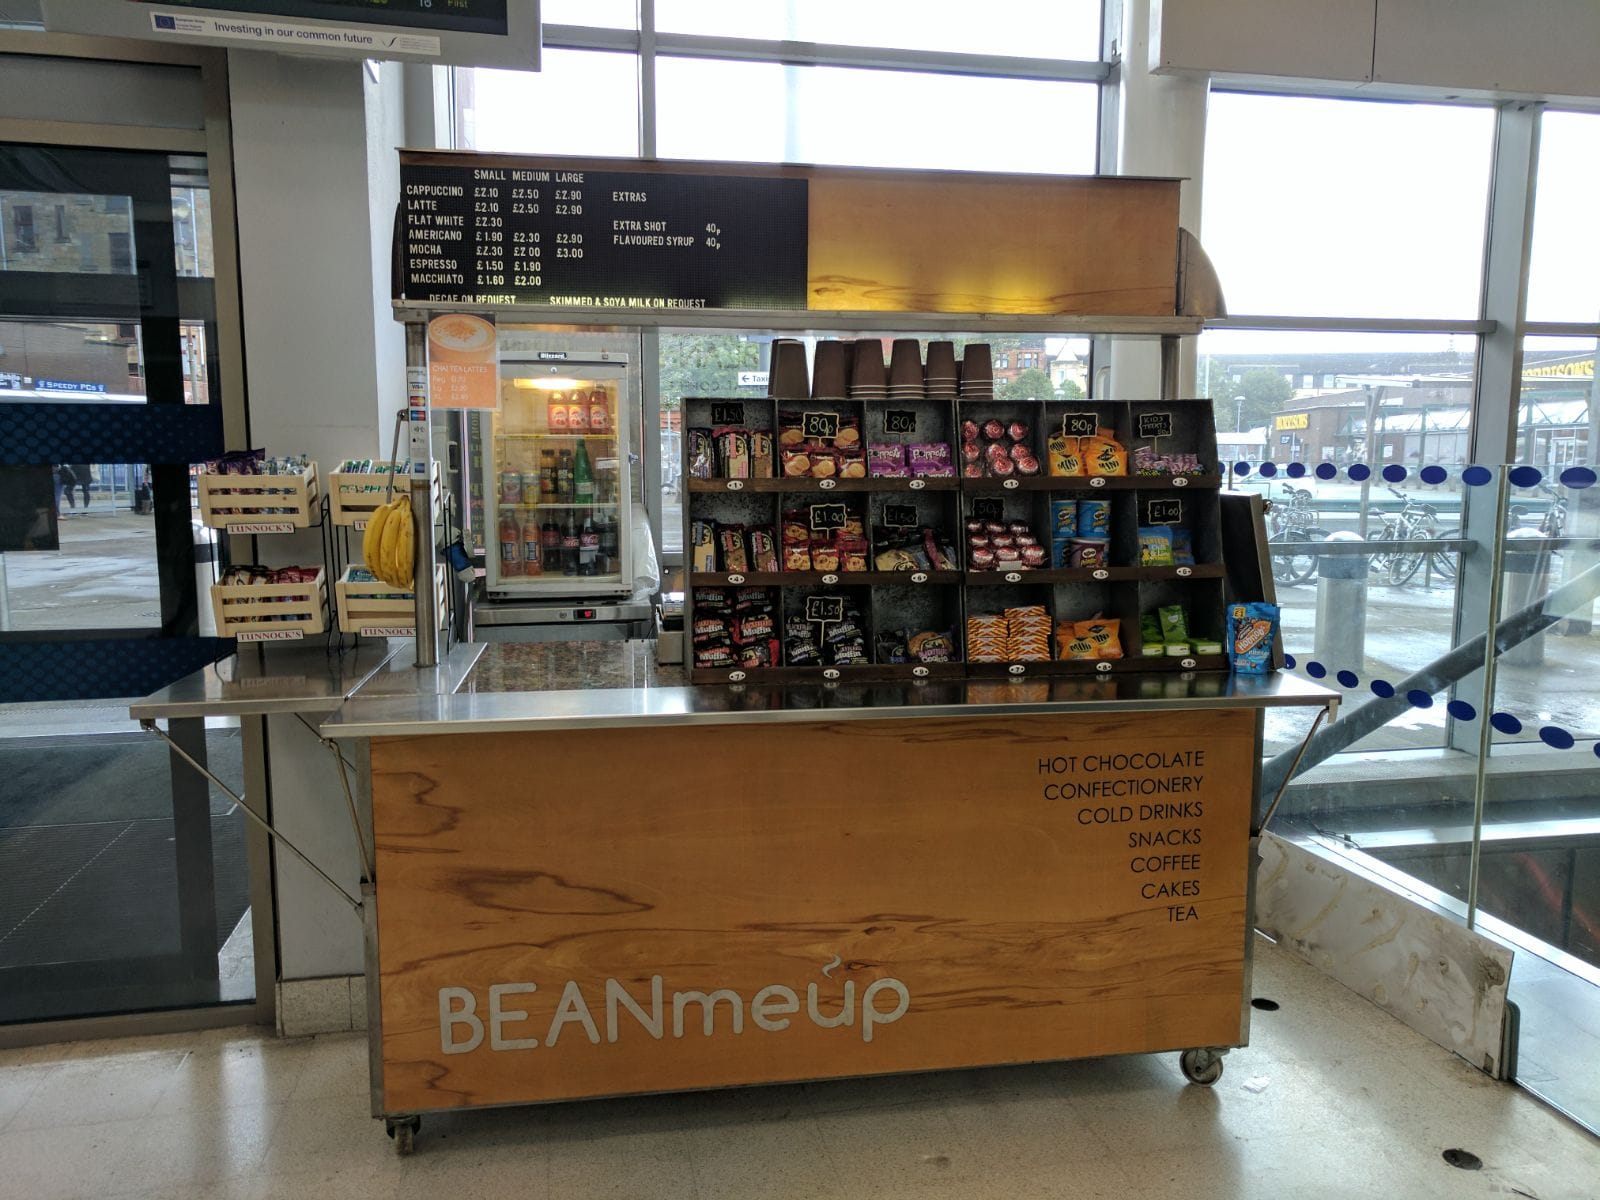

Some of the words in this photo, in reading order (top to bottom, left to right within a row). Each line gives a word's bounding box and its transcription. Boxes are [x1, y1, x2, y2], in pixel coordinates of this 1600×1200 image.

[214, 22, 262, 36] Investing
[264, 26, 274, 36] in
[276, 29, 293, 38] our
[296, 30, 340, 41] common
[343, 32, 373, 44] future
[474, 170, 506, 180] SMALL
[512, 172, 550, 182] MEDIUM
[556, 173, 584, 183] LARGE
[406, 185, 463, 196] CAPPUCCINO
[474, 188, 499, 198] £2.10
[512, 189, 539, 199] £2.50
[555, 190, 582, 200] £2.90
[613, 192, 646, 202] EXTRAS
[407, 200, 437, 210] LATTE
[475, 202, 499, 212] £2.10
[512, 204, 539, 214] £2.50
[556, 205, 582, 215] £2.90
[408, 215, 431, 225] FLAT
[435, 216, 464, 226] WHITE
[475, 217, 502, 227] £2.30
[614, 221, 641, 231] EXTRA
[644, 221, 666, 232] SHOT
[706, 223, 721, 236] 40p
[408, 230, 462, 240] AMERICANO
[513, 233, 540, 242] £2.30
[556, 234, 583, 244] £2.90
[614, 235, 664, 246] FLAVOURED
[666, 236, 694, 247] SYRUP
[706, 237, 721, 250] 40p
[409, 244, 442, 255] MOCHA
[476, 246, 503, 256] £2.30
[556, 248, 583, 258] £3.00
[410, 259, 457, 269] ESPRESSO
[411, 274, 464, 284] MACCHIATO
[514, 276, 541, 286] £2.00
[462, 294, 474, 302] ON
[476, 295, 516, 304] REQUEST
[550, 296, 592, 307] SKIMMED
[603, 298, 626, 307] SOYA
[628, 298, 650, 308] MILK
[654, 298, 664, 308] ON
[667, 299, 706, 308] REQUEST
[46, 381, 77, 390] SPEEDY
[809, 417, 833, 436] 80p
[891, 416, 915, 432] 80p
[1071, 419, 1092, 435] 80p
[1057, 458, 1078, 470] MINI
[1098, 460, 1119, 470] MINI
[229, 524, 292, 533] TUNNOCK'S
[811, 601, 840, 616] £1.50
[241, 632, 302, 641] TUNNOCK'S
[695, 625, 723, 634] Muffin
[743, 627, 772, 636] Muffin
[1038, 756, 1077, 774] HOT
[1083, 751, 1205, 772] CHOCOLATE
[1044, 776, 1204, 800] CONFECTIONERY
[1078, 806, 1133, 824] COLD
[1140, 802, 1203, 821] DRINKS
[1129, 828, 1201, 848] SNACKS
[1131, 854, 1200, 872] COFFEE
[1141, 880, 1200, 899] CAKES
[1167, 906, 1198, 922] TEA
